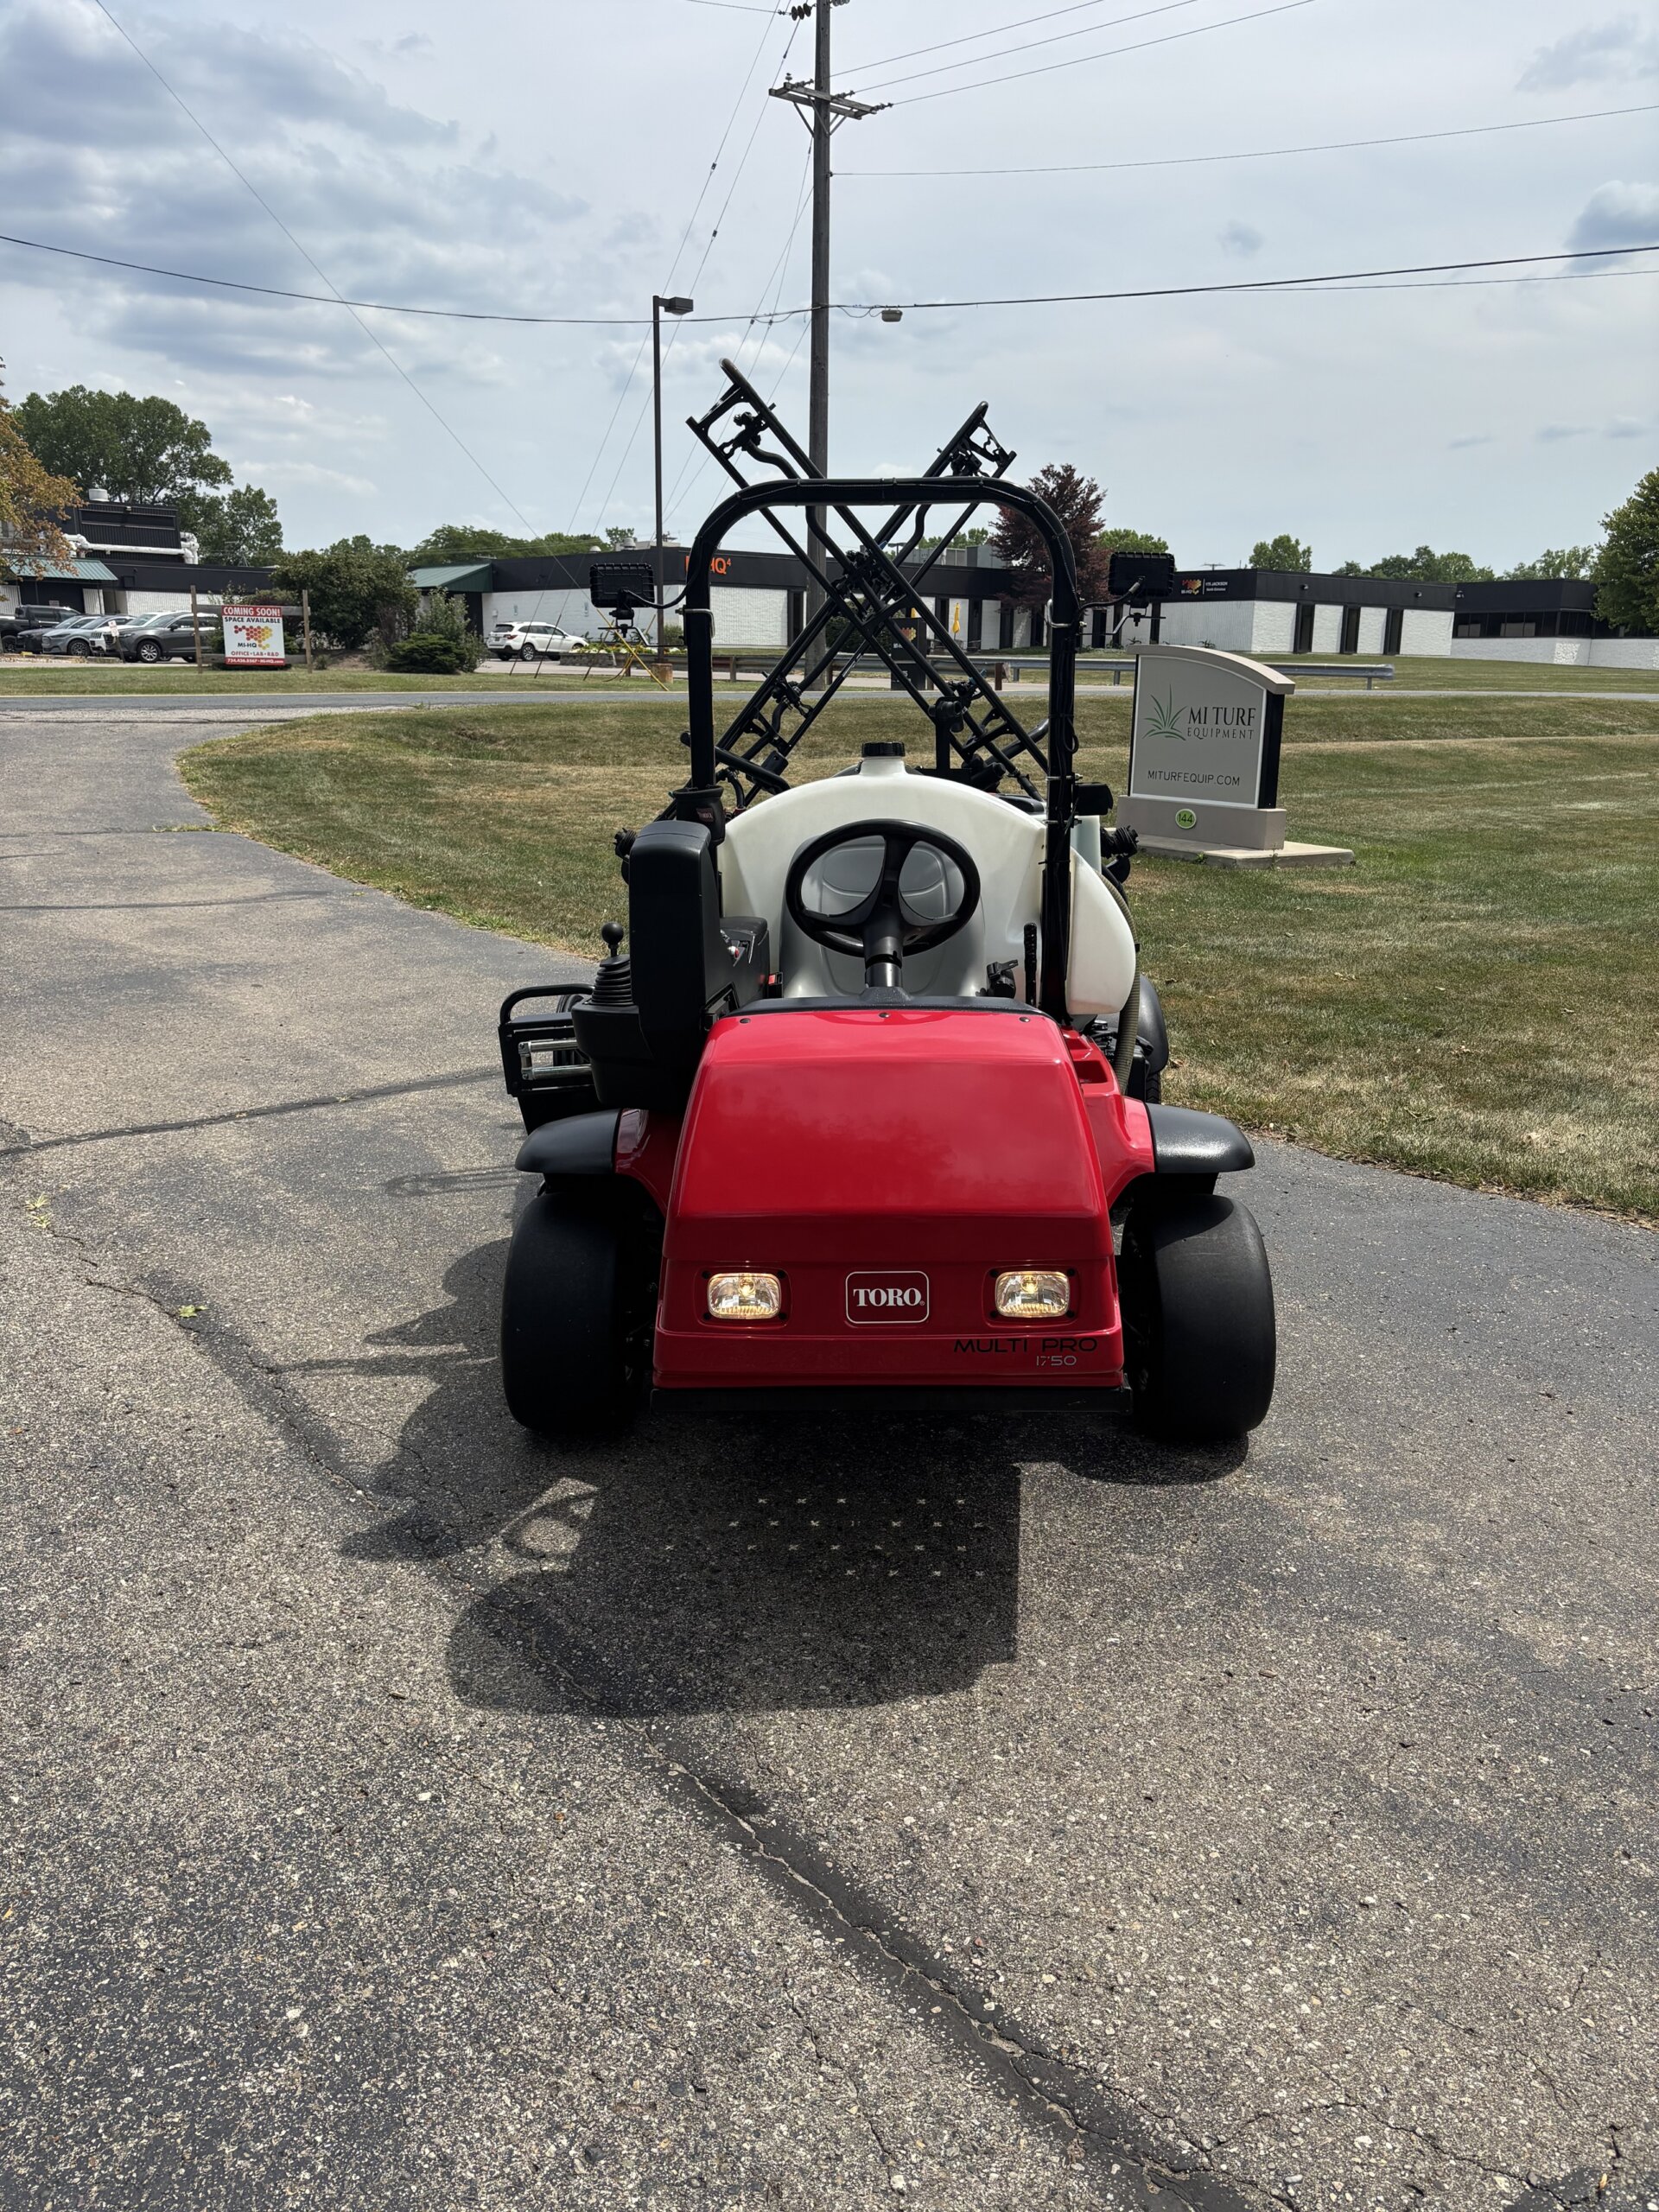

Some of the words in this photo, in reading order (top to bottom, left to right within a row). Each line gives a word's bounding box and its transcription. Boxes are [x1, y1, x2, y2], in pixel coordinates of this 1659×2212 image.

[223, 607, 254, 615] COMING
[256, 607, 281, 617] SOON!
[1188, 706, 1208, 725] MI
[1212, 706, 1256, 727] TURF
[1187, 727, 1255, 740] EQUIPMENT
[1147, 770, 1240, 786] MITURFEQUIP.COM
[1178, 813, 1193, 823] 144
[853, 1287, 922, 1307] TORO
[953, 1338, 1027, 1353] MULTI
[1041, 1337, 1097, 1352] PRO
[1036, 1355, 1077, 1366] 1750
